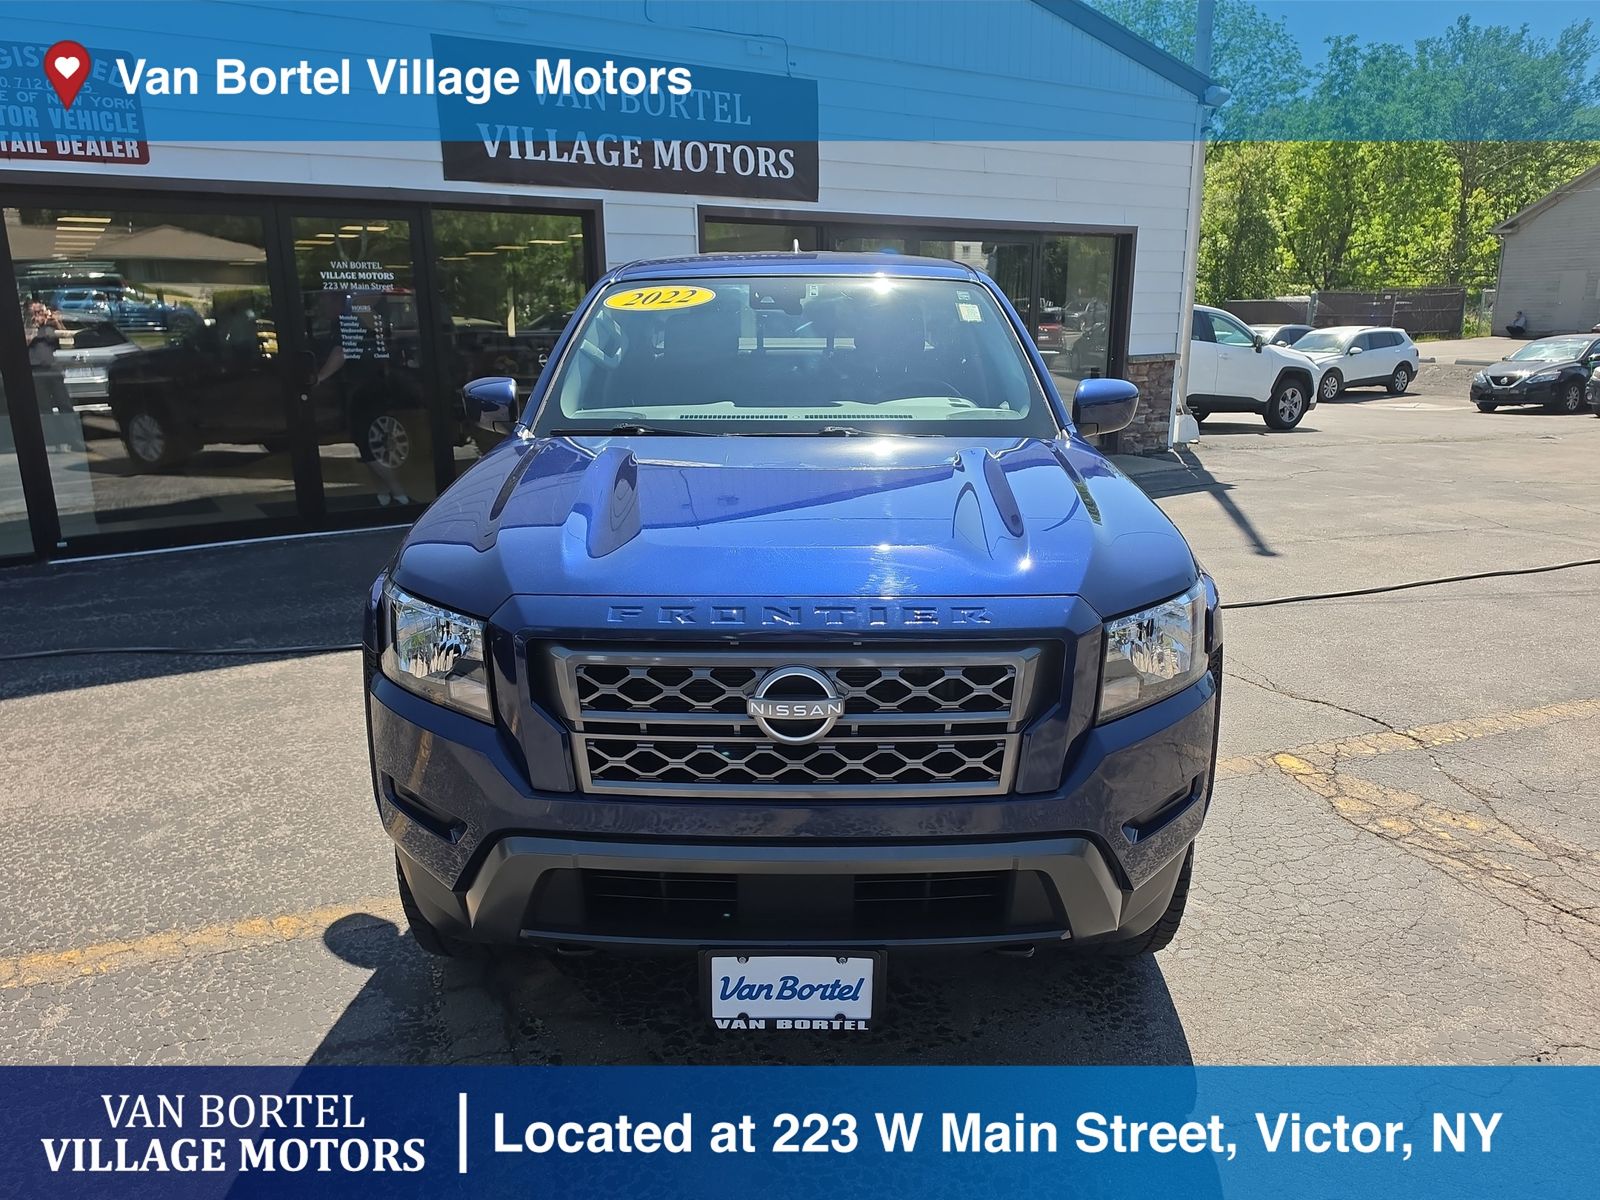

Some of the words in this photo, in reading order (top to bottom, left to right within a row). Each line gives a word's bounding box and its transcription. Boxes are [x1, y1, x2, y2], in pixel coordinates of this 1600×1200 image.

[16, 91, 38, 103] OF
[46, 93, 82, 106] NW
[89, 96, 136, 110] YORK
[620, 79, 751, 125] BORTEL
[48, 107, 139, 134] VEHICLE
[55, 133, 140, 158] DEALER
[476, 123, 643, 168] VILLAGE
[652, 138, 795, 179] MOTORS
[330, 261, 348, 269] VAN
[350, 261, 382, 270] BORTEL
[320, 272, 357, 280] VILLAGE
[358, 272, 395, 280] MOTORS
[323, 282, 338, 290] 223
[340, 282, 349, 290] W
[350, 282, 370, 291] Main
[371, 282, 394, 292] Street
[622, 289, 697, 306] 2022
[607, 605, 993, 626] FRONTIER
[750, 702, 843, 717] NISSAN
[720, 976, 774, 1001] Van
[776, 976, 865, 1001] Bortel
[715, 1019, 766, 1030] VAN
[776, 1019, 869, 1031] BORTEL
